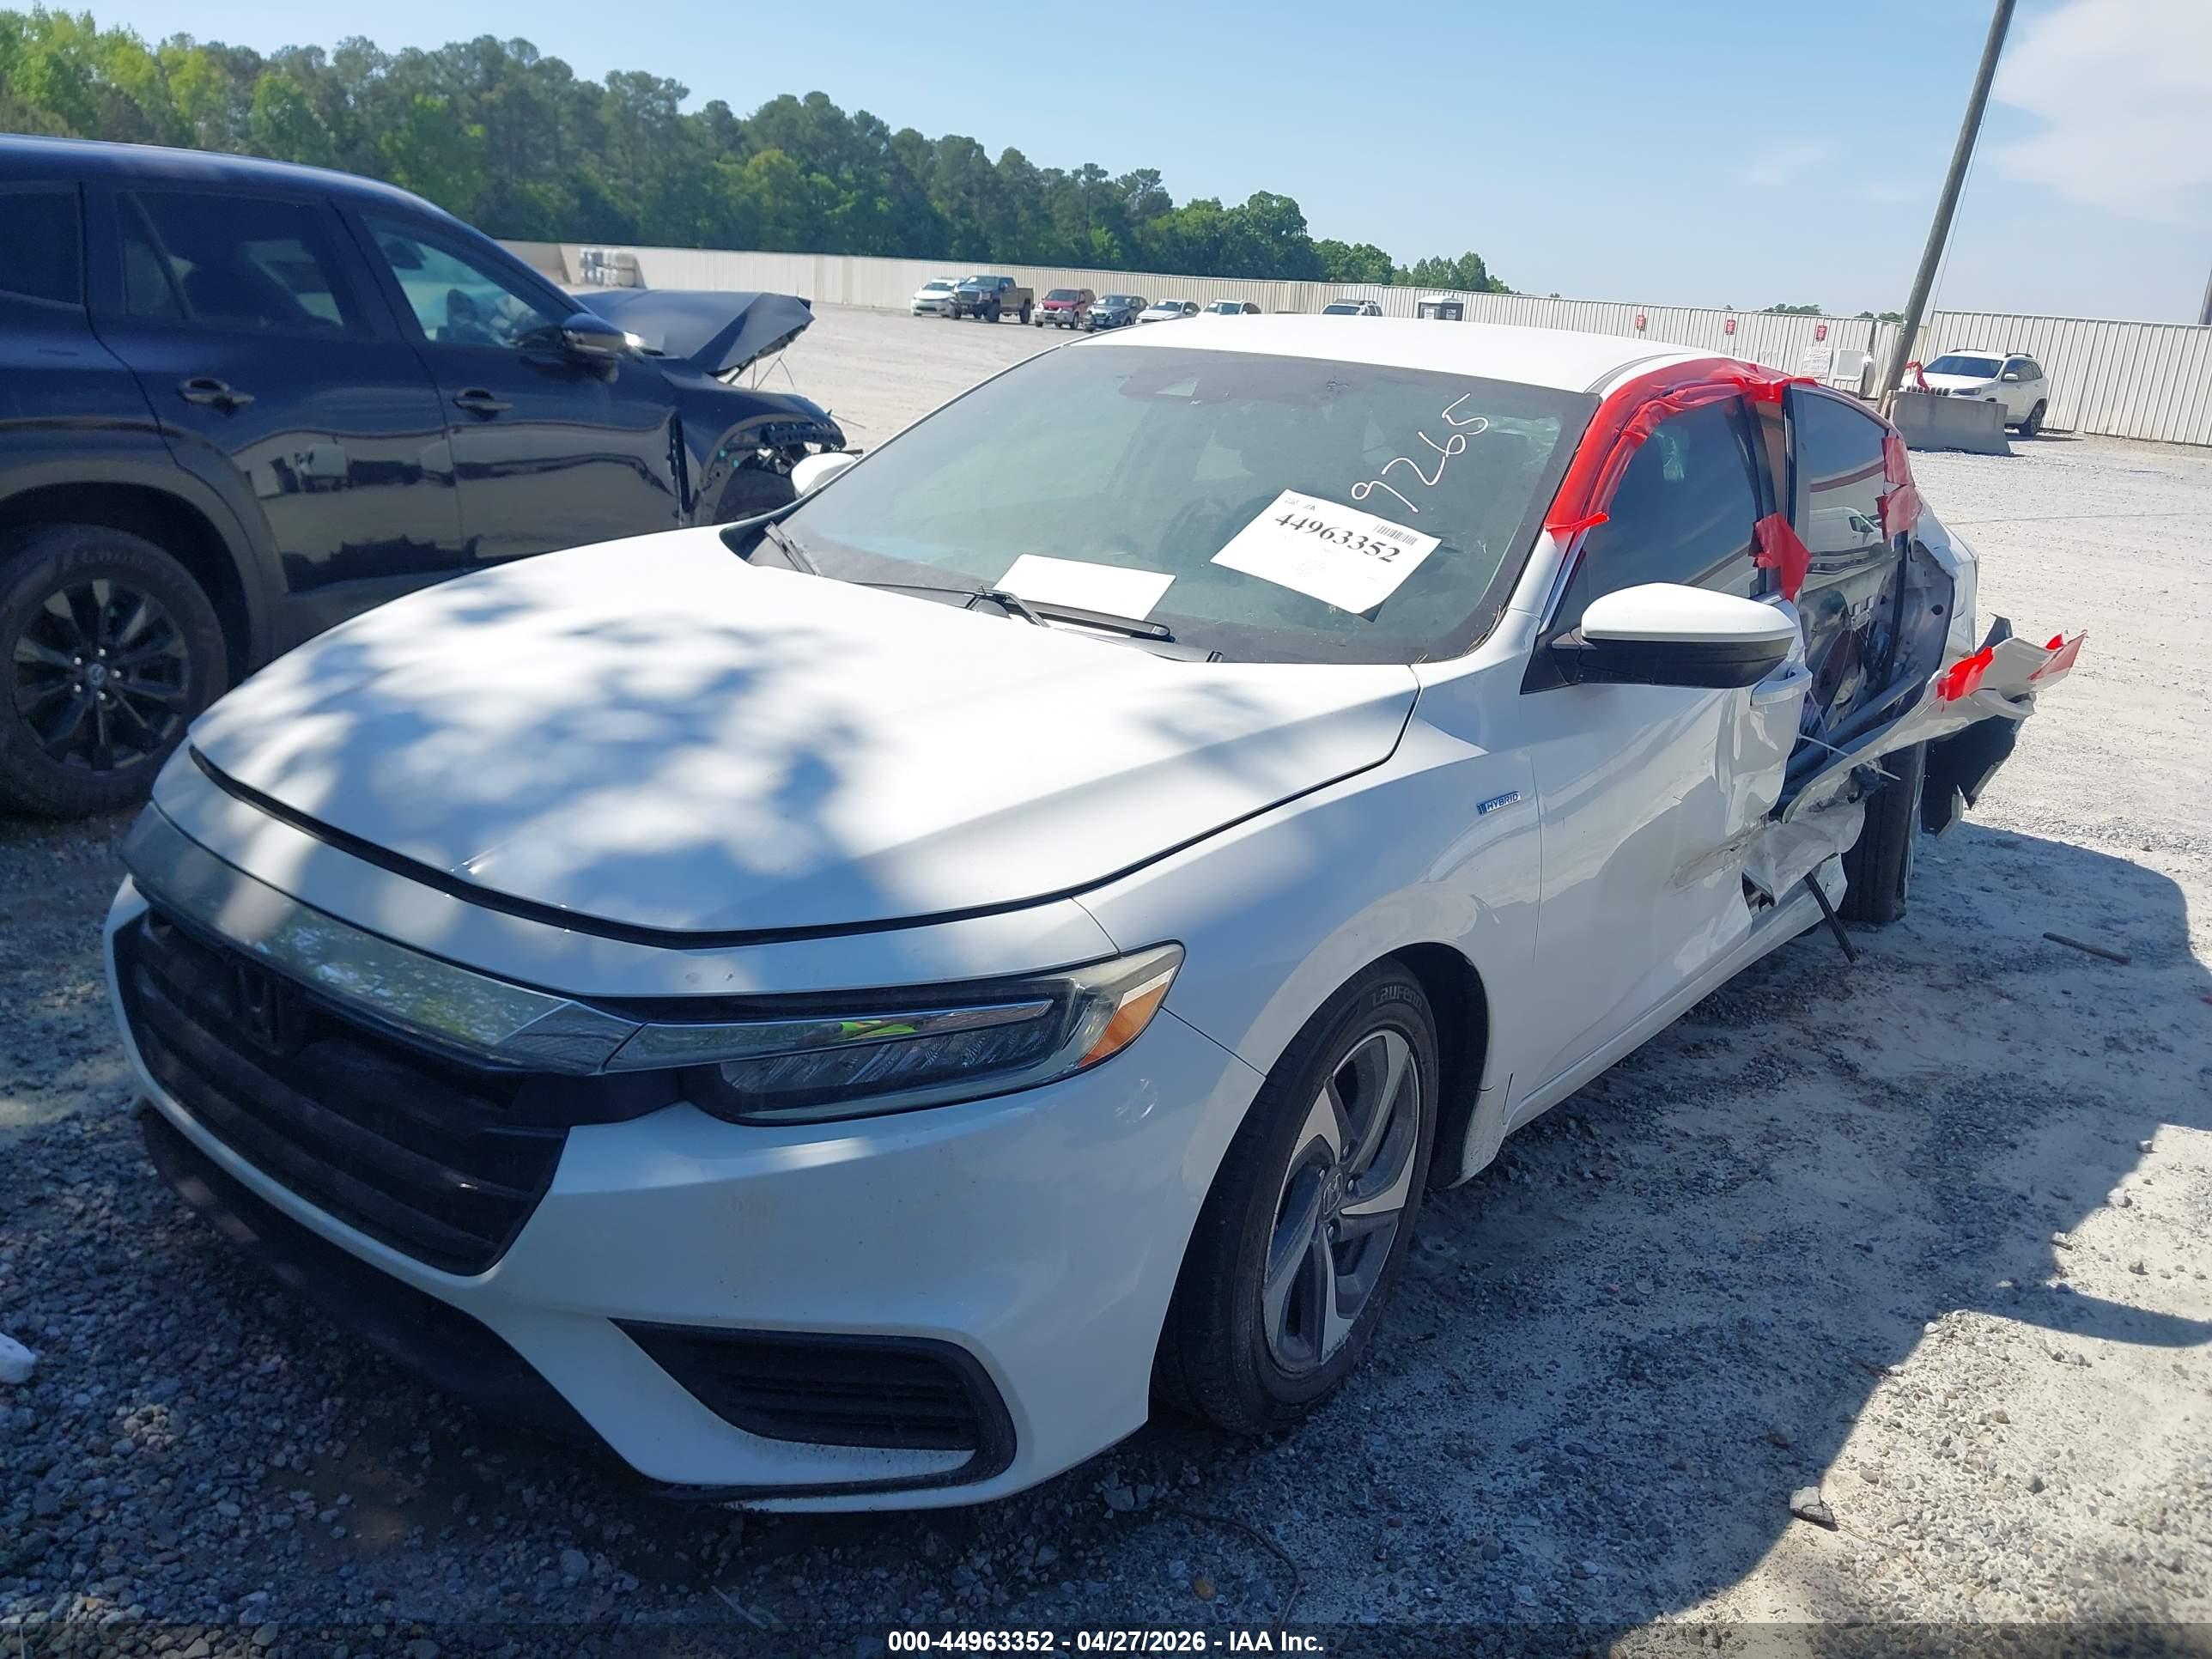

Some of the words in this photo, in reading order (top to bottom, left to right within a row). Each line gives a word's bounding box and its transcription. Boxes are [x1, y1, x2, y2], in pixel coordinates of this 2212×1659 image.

[1351, 392, 1489, 513] 9265
[1275, 513, 1401, 563] 44963352
[1486, 793, 1519, 811] HYBRID
